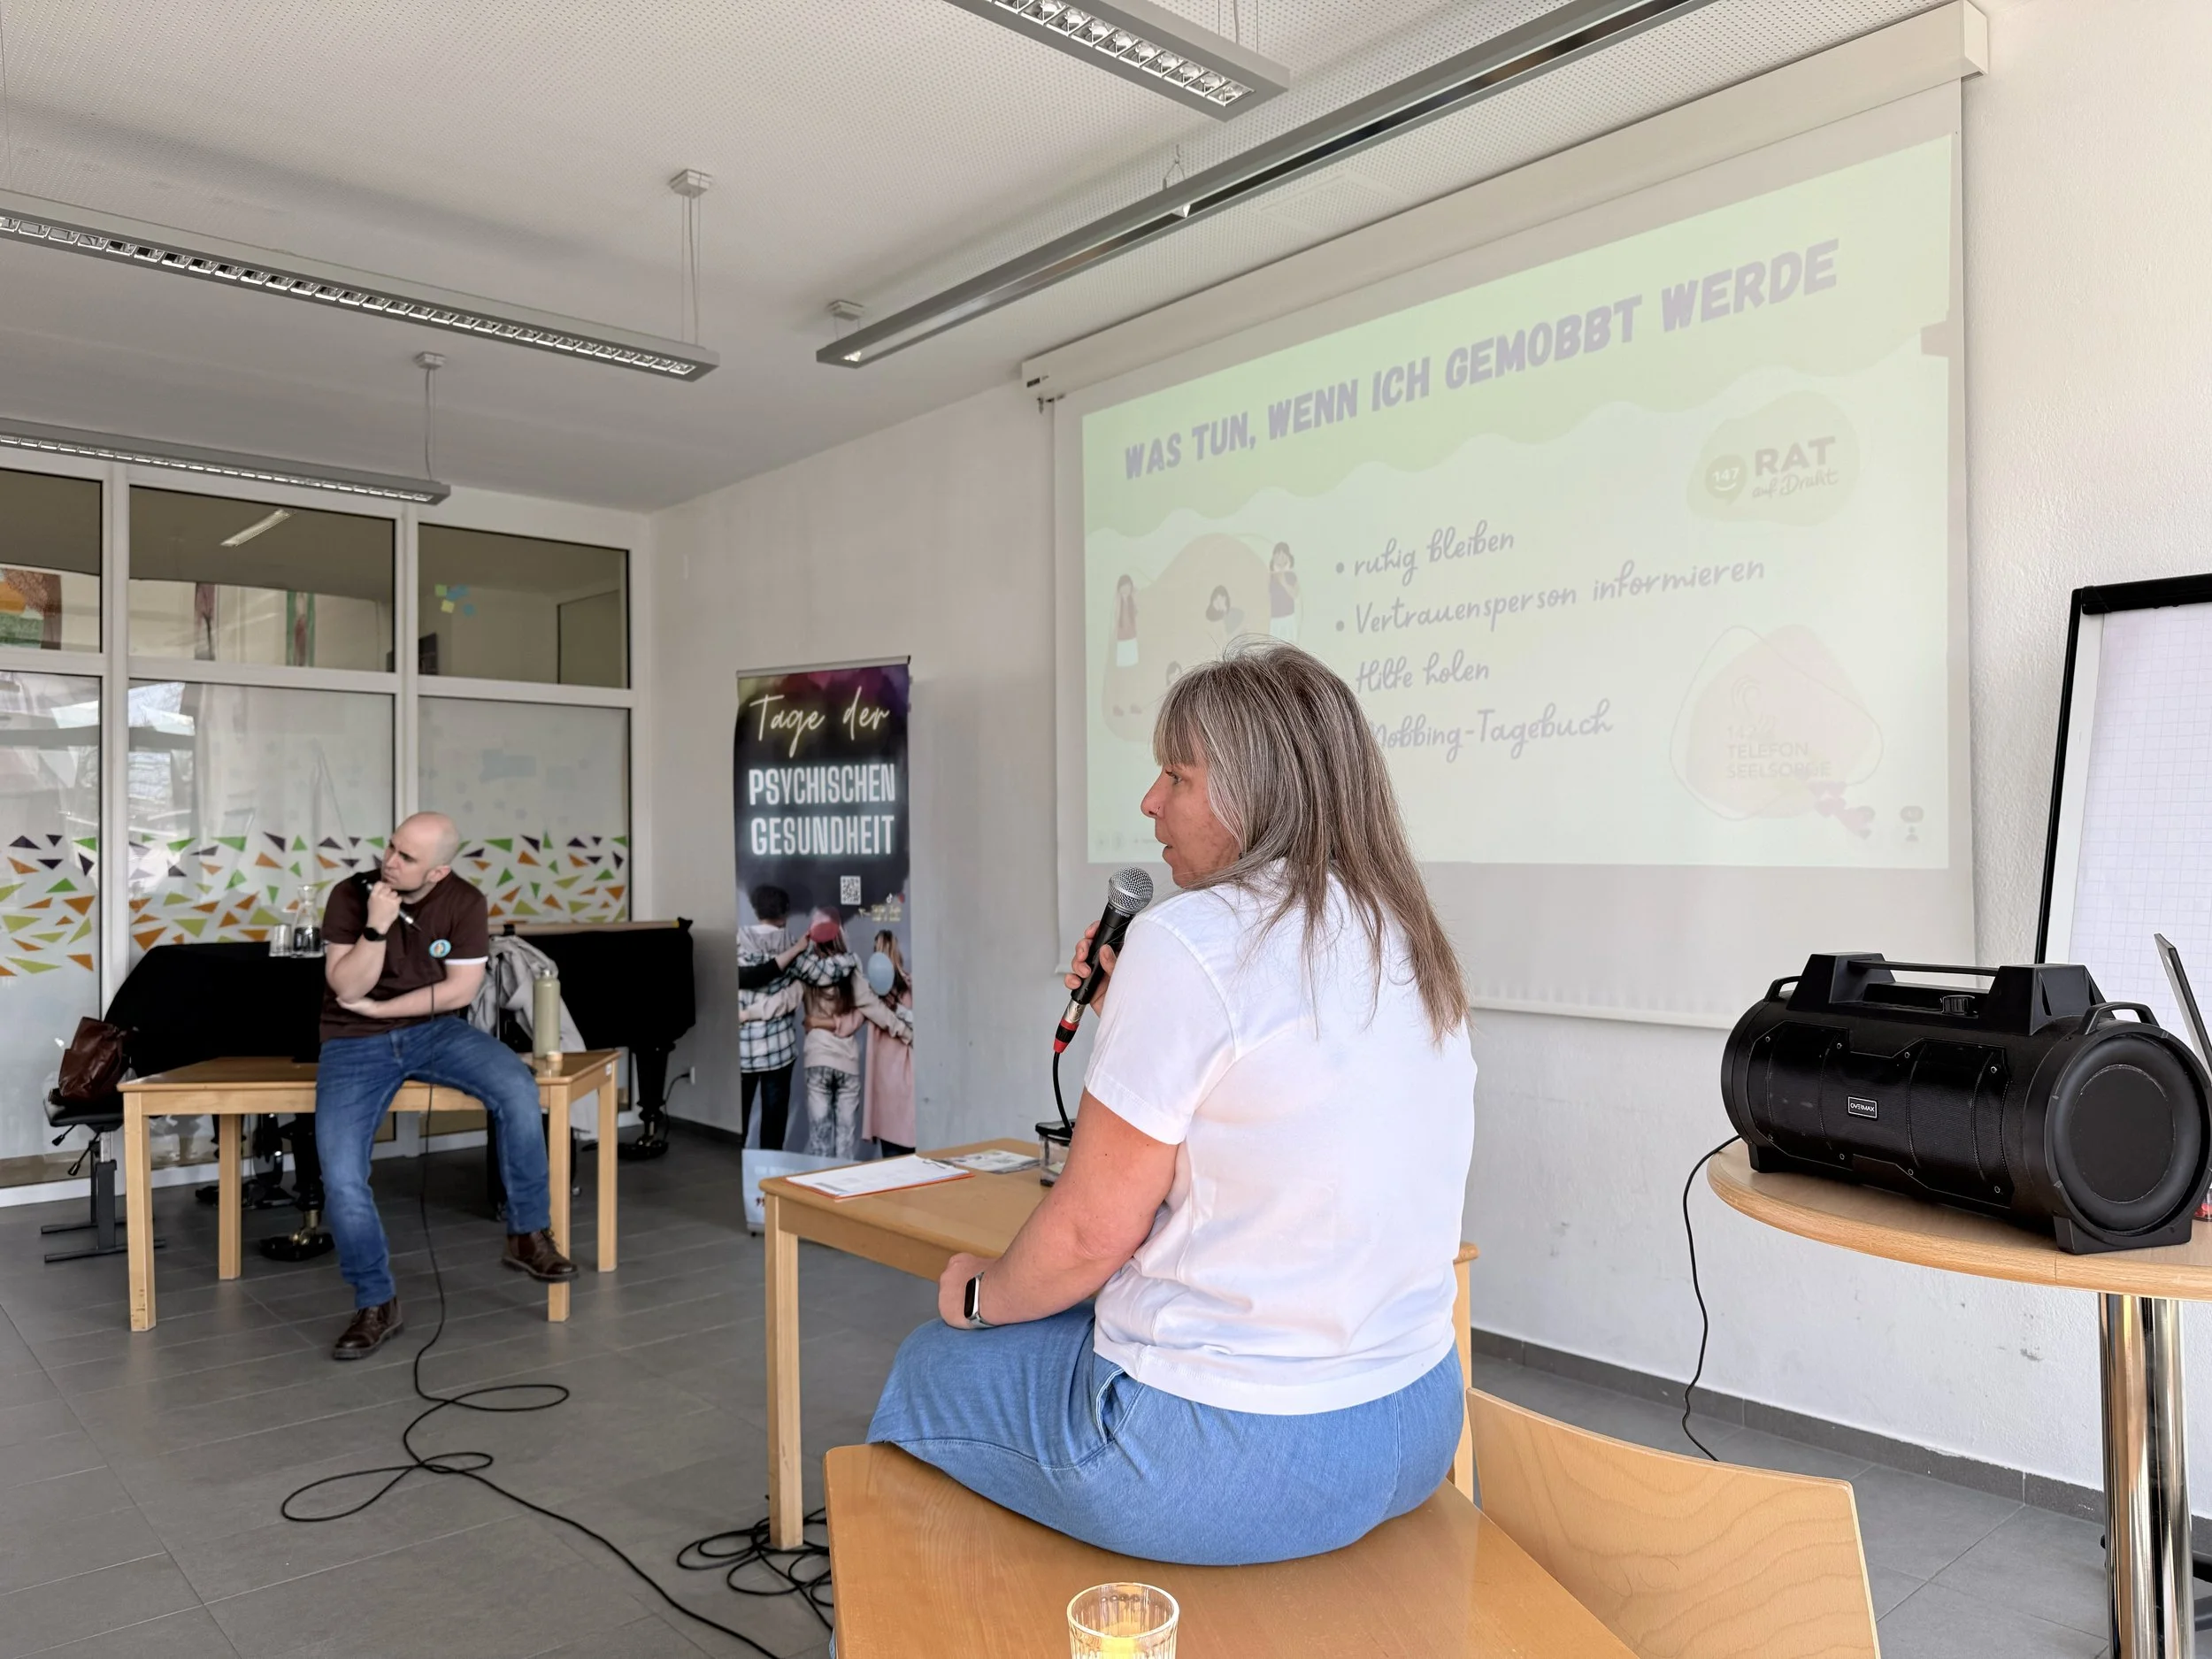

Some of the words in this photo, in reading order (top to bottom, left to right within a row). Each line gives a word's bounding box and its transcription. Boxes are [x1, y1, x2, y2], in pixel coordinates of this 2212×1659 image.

[1125, 432, 1182, 480] WAS
[1191, 411, 1256, 461] TUN,
[1268, 379, 1359, 441] WENN
[1371, 356, 1431, 412] ICH
[1445, 294, 1642, 390] GEMOBBT
[1661, 237, 1839, 334] WERDE
[1711, 466, 1741, 483] 147
[1755, 435, 1836, 477] RAT
[1752, 479, 1778, 500] auf
[1354, 537, 1418, 587] ruhig
[1428, 519, 1514, 565] bleiben
[1355, 584, 1578, 633] Vertrauensperson
[1593, 559, 1765, 603] informieren
[1356, 655, 1414, 695] Hilfe
[1423, 649, 1490, 687] holen
[749, 694, 826, 758] Tage
[842, 686, 891, 741] der
[1725, 741, 1809, 759] TELEFON
[749, 764, 895, 806] PSYCHISCHEN
[750, 815, 895, 856] GESUNDHEIT
[1850, 1102, 1875, 1112] OVERMAX
